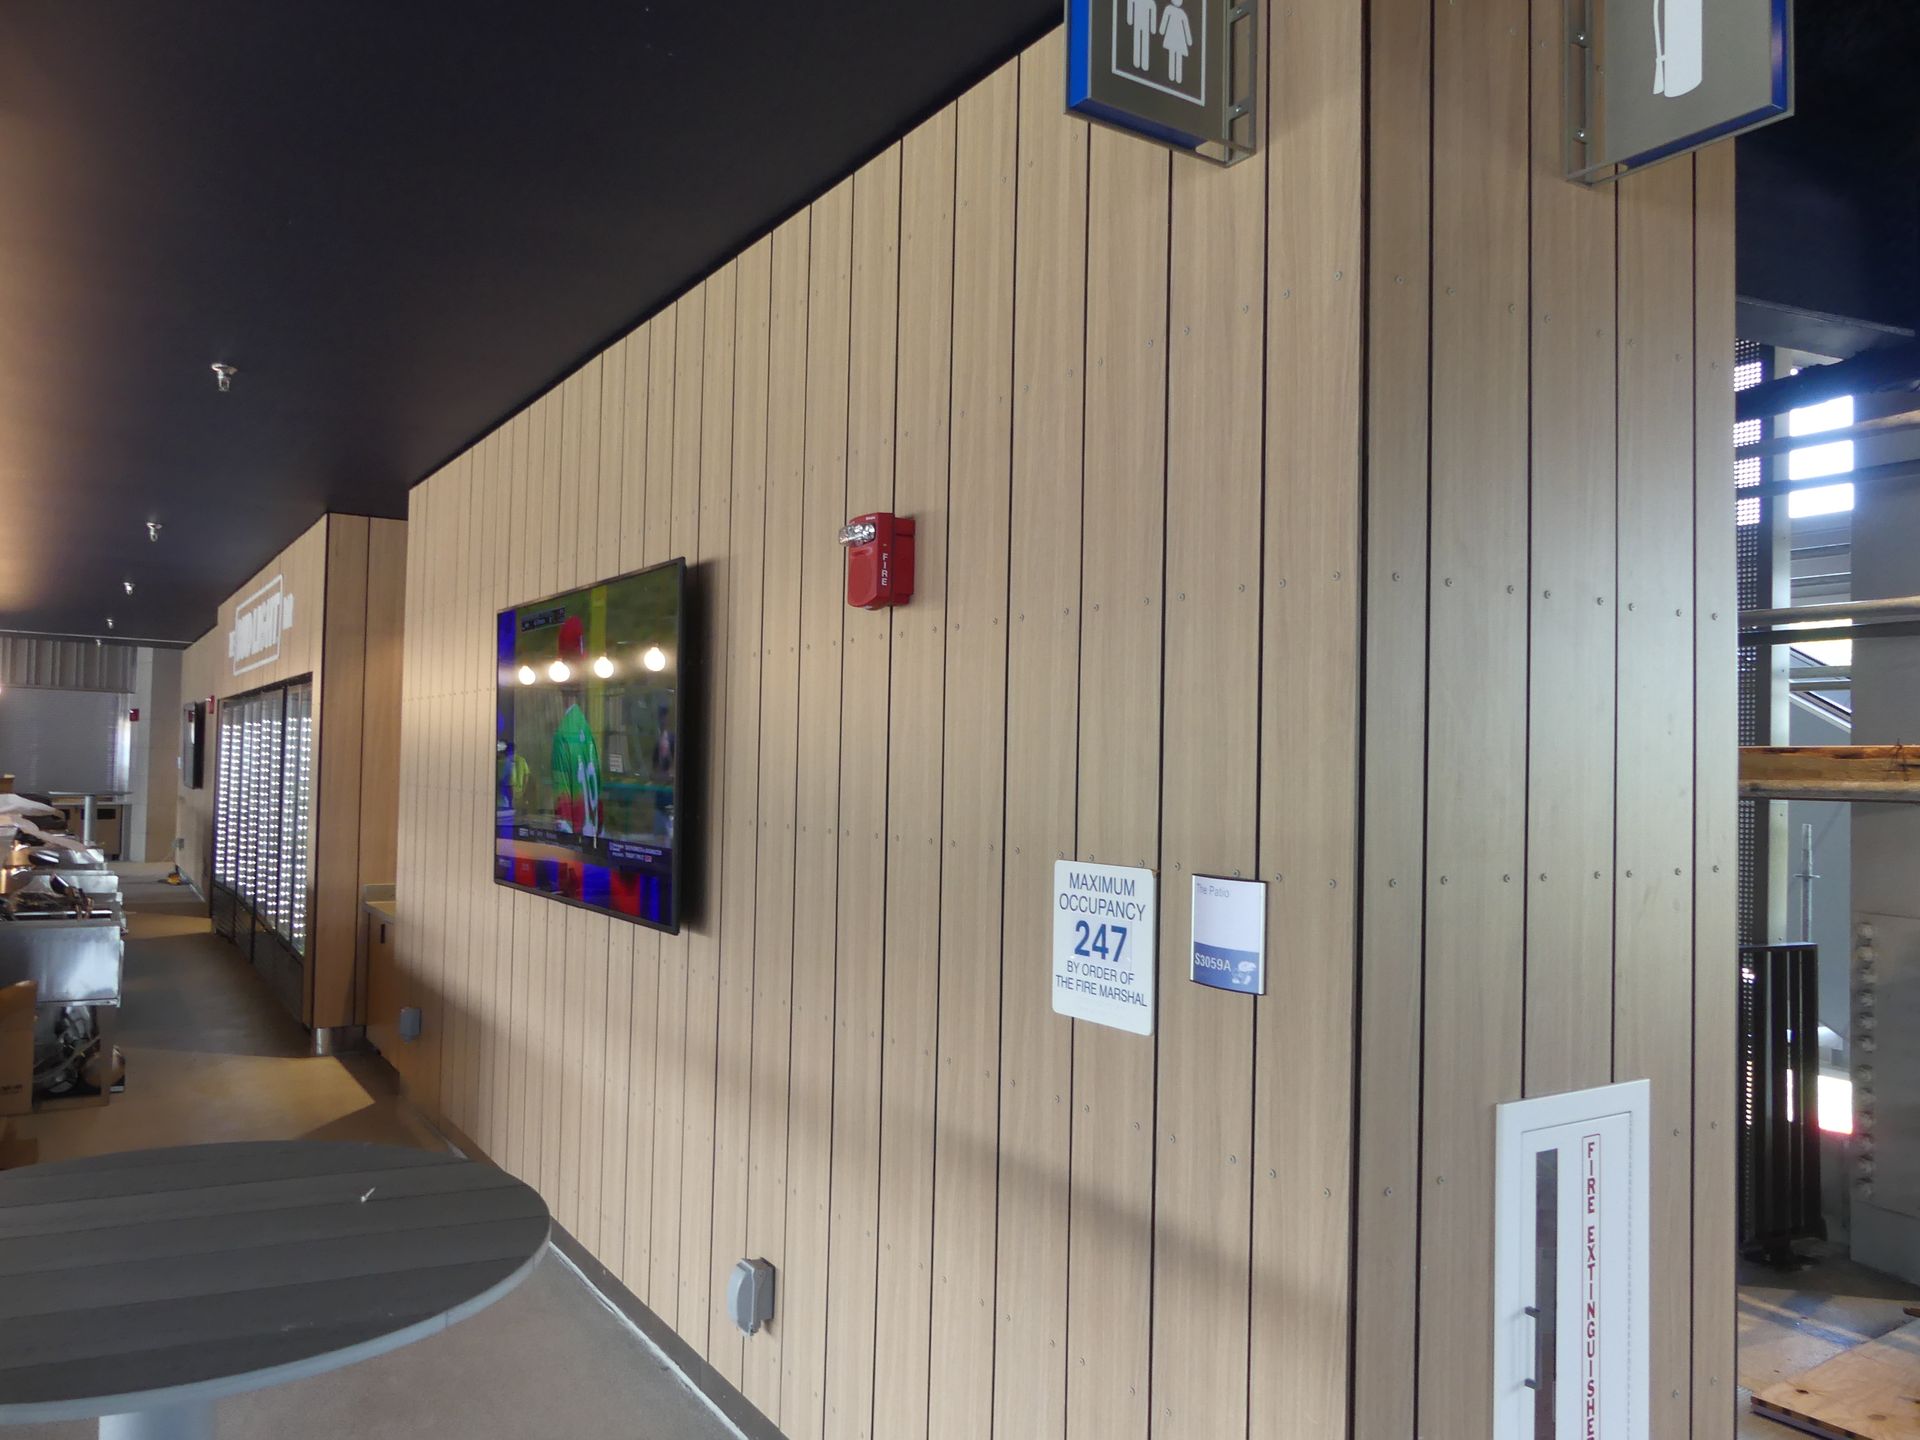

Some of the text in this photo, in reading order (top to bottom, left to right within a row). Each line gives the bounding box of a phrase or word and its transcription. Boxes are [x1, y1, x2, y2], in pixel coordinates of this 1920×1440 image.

[1069, 872, 1135, 897] MAXIMUM
[1059, 893, 1146, 921] OCCUPANCY
[1074, 920, 1127, 962] 247
[1067, 960, 1135, 985] BY ORDER OF
[1194, 952, 1232, 972] S3059A
[1055, 974, 1148, 1007] THE FIRE MARSHAL
[1586, 1142, 1596, 1440] FIRE EXTINGUISHE
